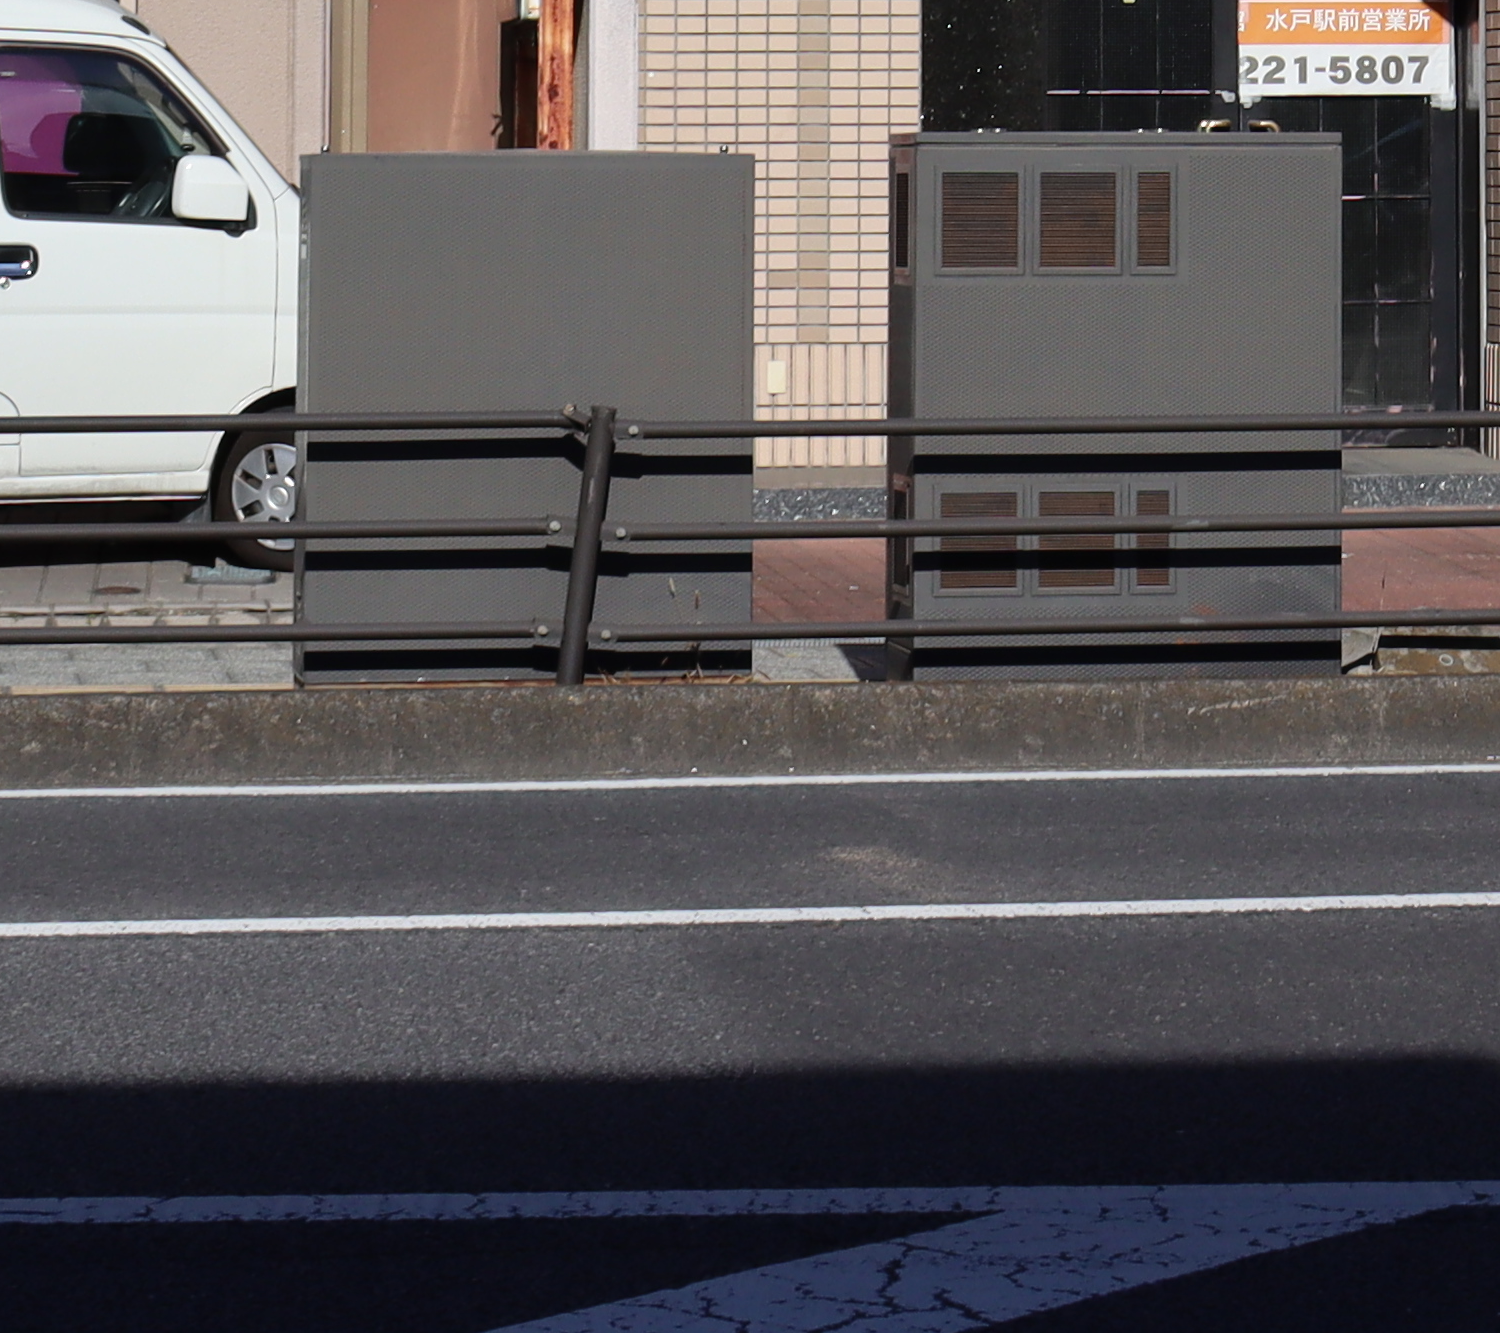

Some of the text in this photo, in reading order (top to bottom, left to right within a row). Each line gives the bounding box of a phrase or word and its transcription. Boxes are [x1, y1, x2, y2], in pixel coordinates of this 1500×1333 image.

[1265, 8, 1432, 32] 水戸駅前営業所
[1240, 55, 1430, 85] 221-5807
